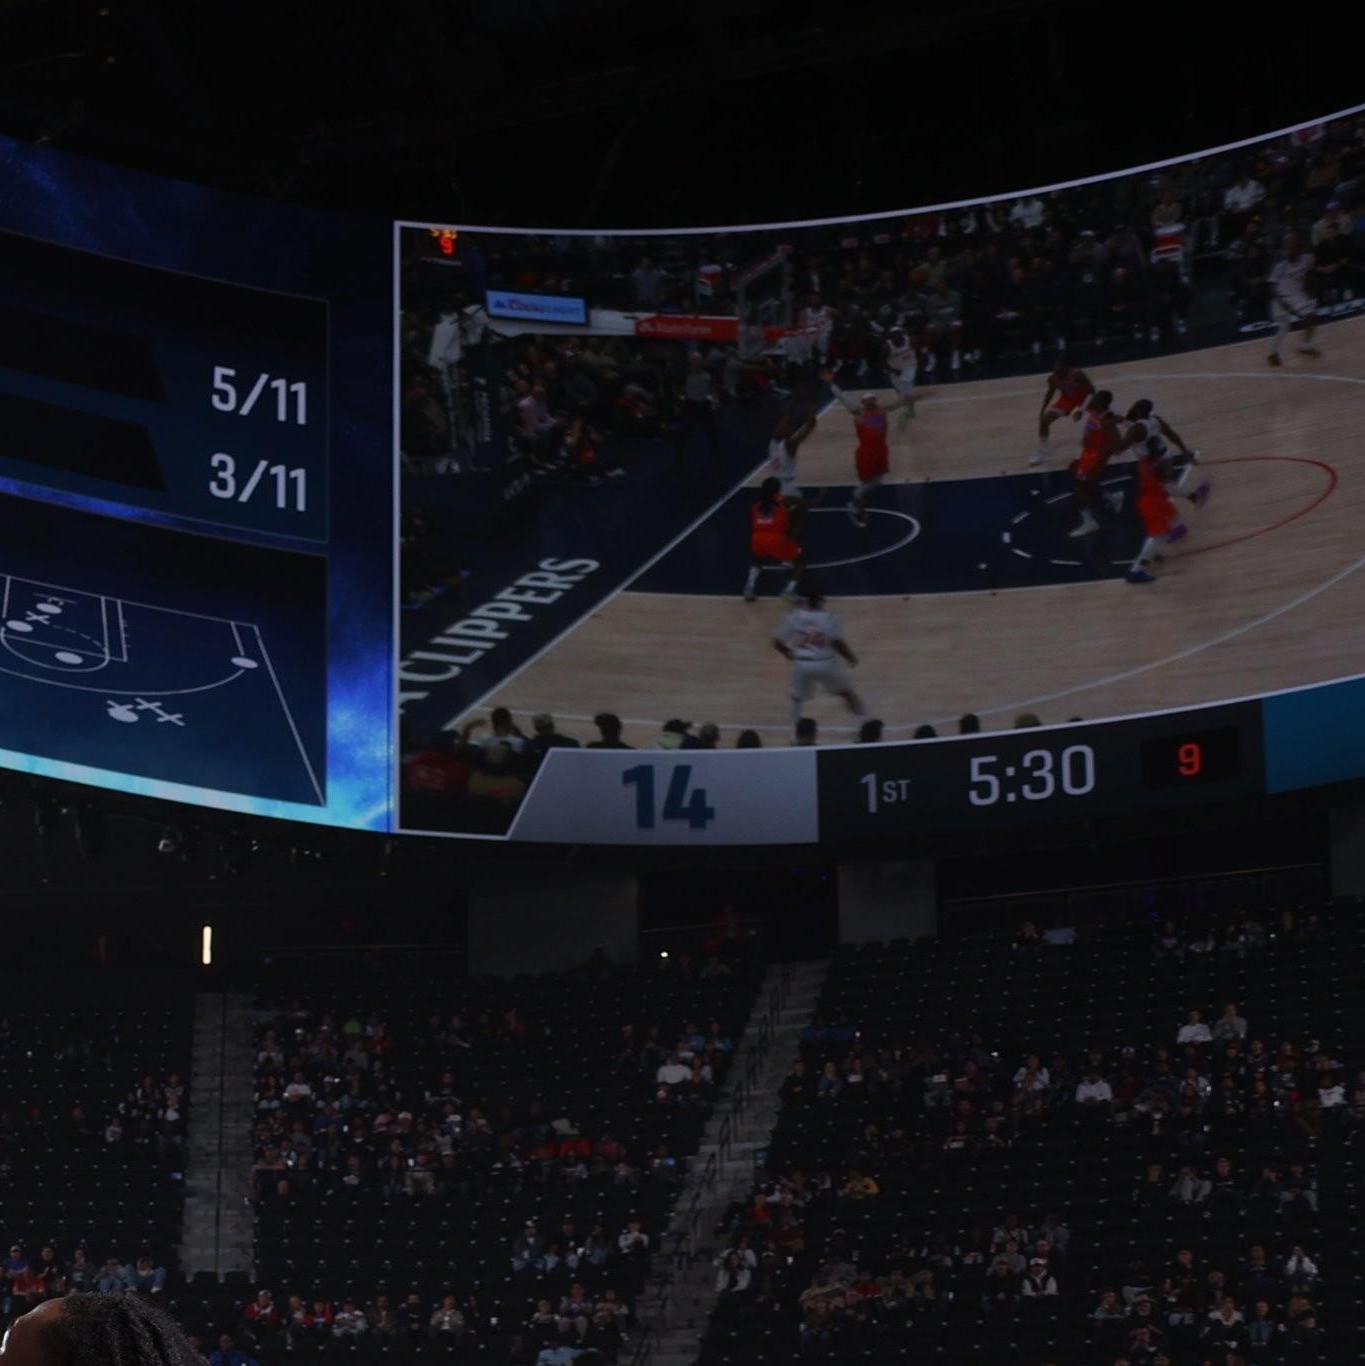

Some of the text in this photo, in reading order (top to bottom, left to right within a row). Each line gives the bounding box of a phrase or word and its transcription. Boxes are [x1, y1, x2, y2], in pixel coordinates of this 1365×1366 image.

[211, 366, 307, 425] 5/11
[209, 452, 307, 512] 3/11
[406, 557, 602, 683] CLIPPERS
[622, 765, 714, 831] 14
[968, 745, 1095, 807] 5:30
[1178, 744, 1202, 776] 9
